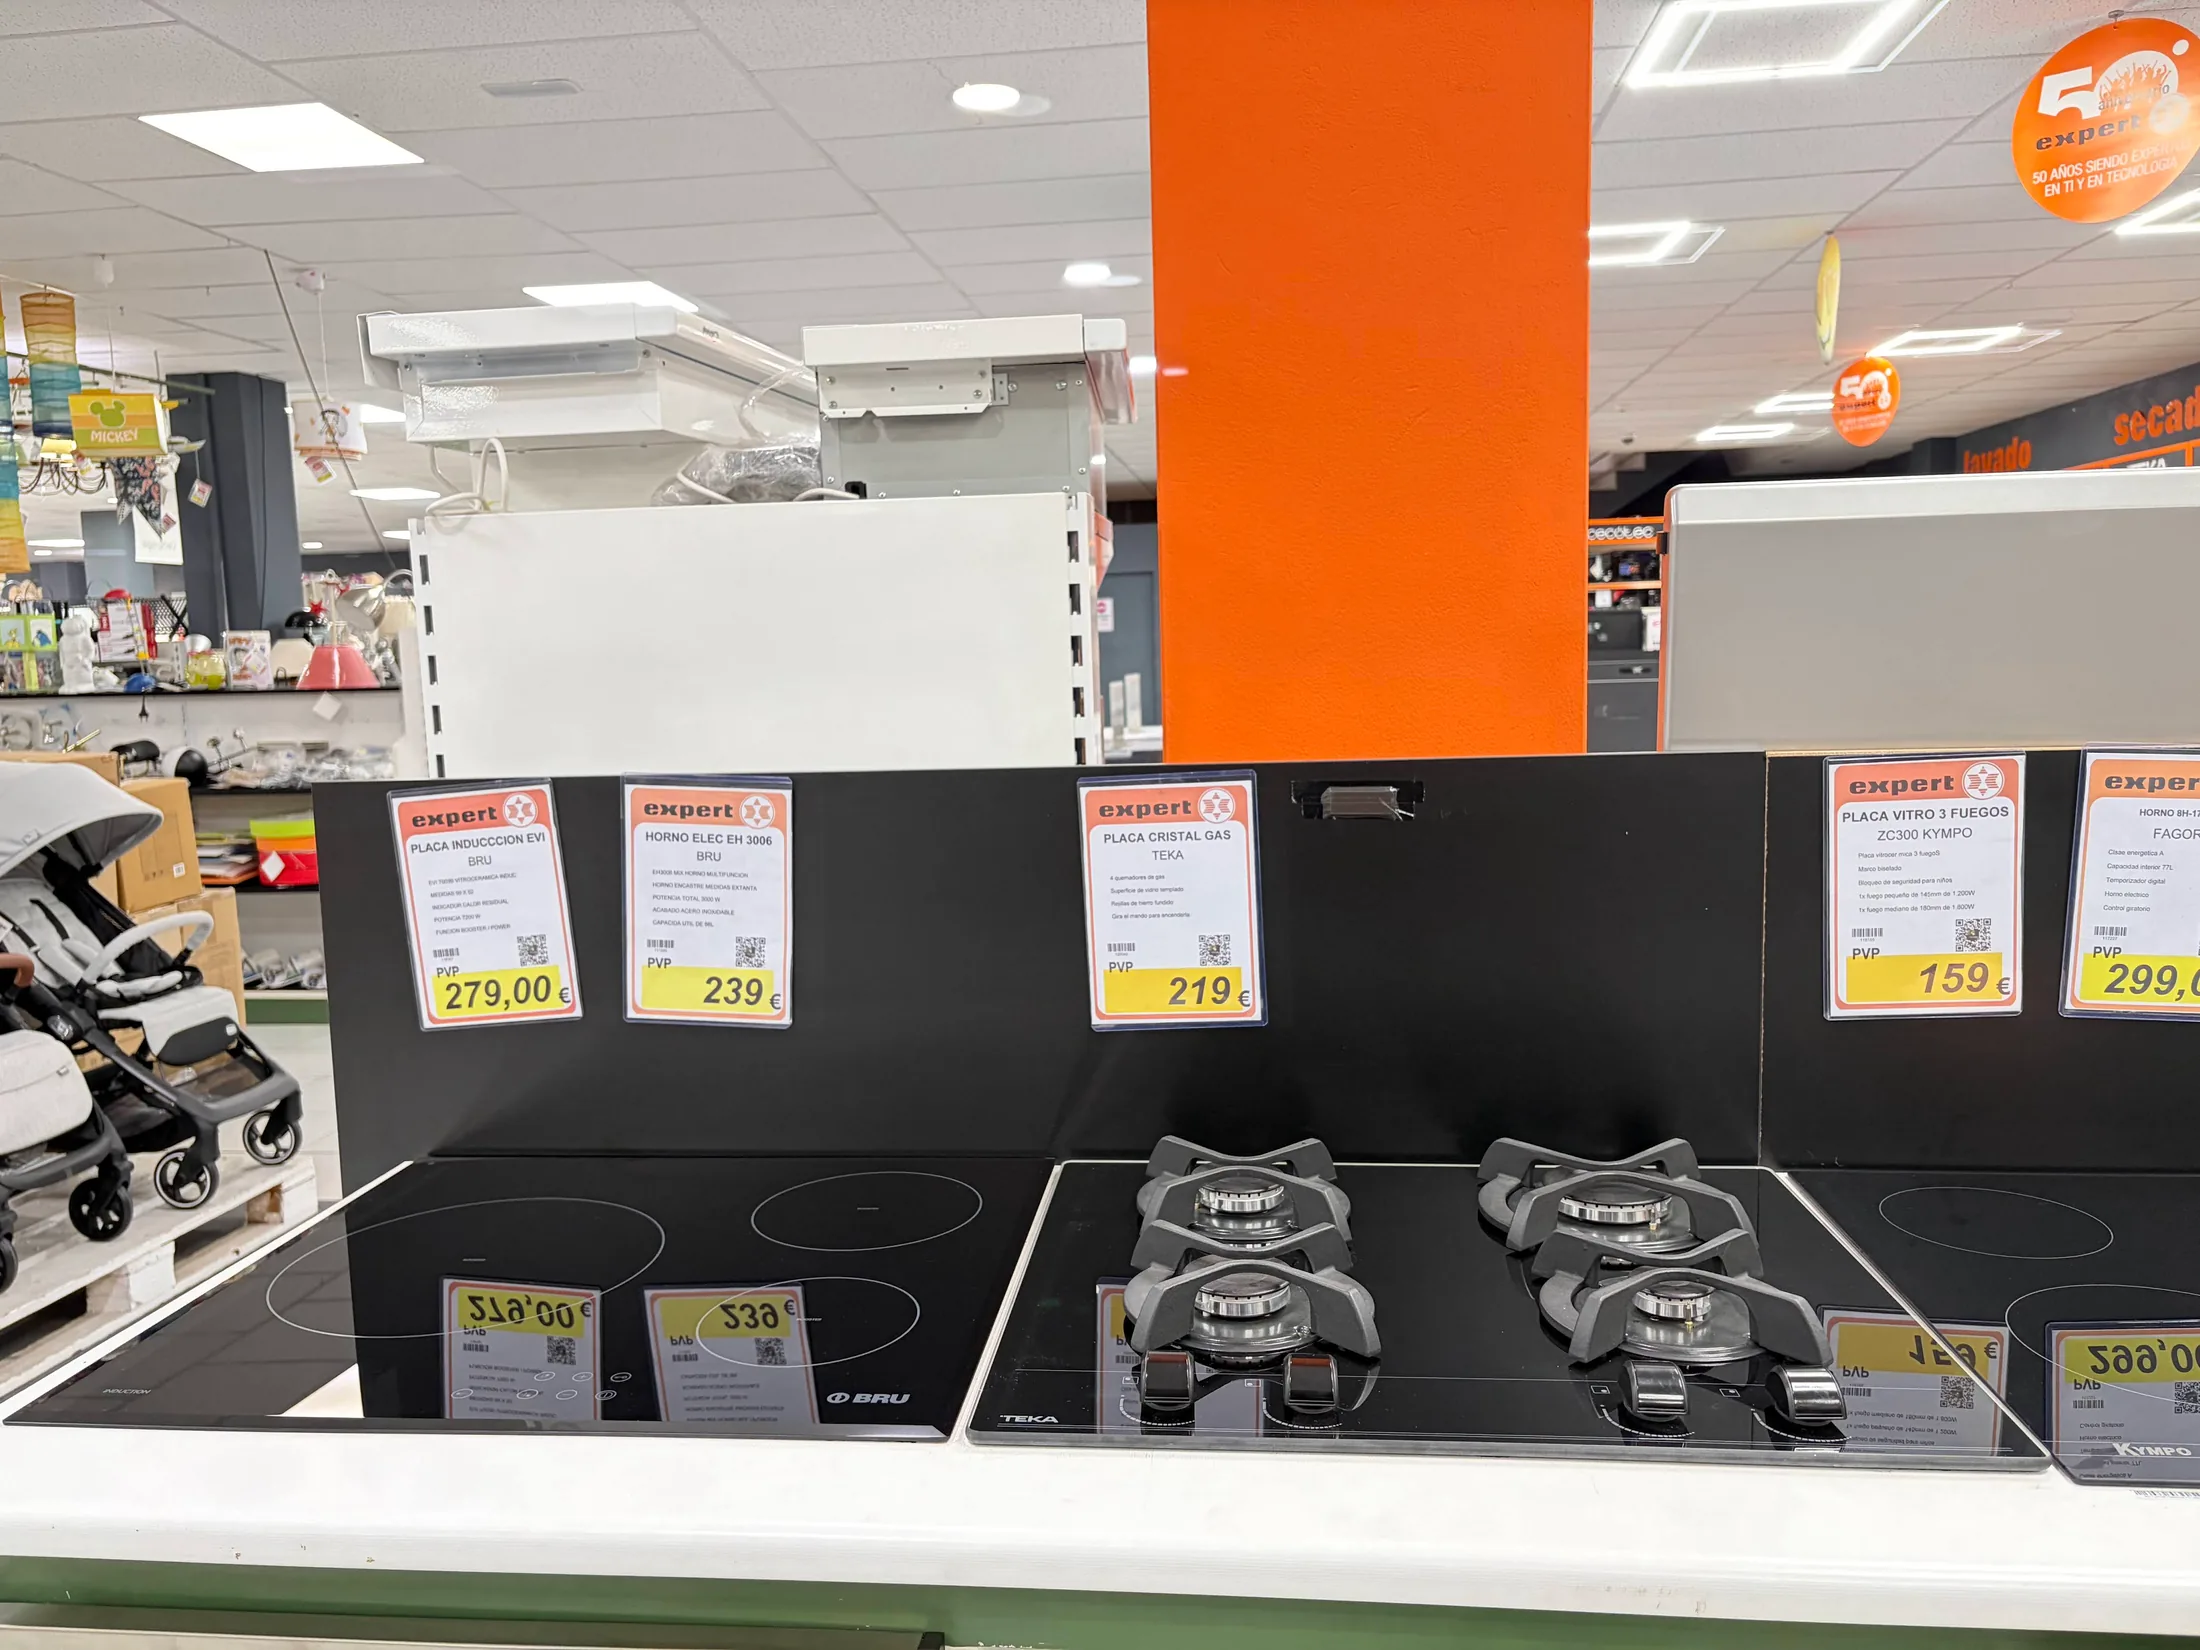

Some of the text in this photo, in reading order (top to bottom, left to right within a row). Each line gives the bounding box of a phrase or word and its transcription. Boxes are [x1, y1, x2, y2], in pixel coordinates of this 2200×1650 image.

[2036, 114, 2142, 150] expert
[2032, 153, 2129, 185] 50 AÑOS SIENDO
[2044, 182, 2060, 197] EN
[2063, 179, 2075, 193] TI
[2077, 176, 2084, 190] Y
[2087, 173, 2103, 189] EN
[91, 428, 139, 444] MICKEY
[1963, 436, 2033, 474] lavado
[1849, 775, 1954, 796] expert
[2105, 776, 2200, 793] exper
[412, 806, 498, 827] expert
[644, 803, 733, 819] expert
[1099, 800, 1192, 819] expert
[1842, 806, 2009, 823] PLACA VITRO 3 FUEGOS
[2139, 808, 2174, 817] HORNO
[645, 831, 772, 845] HORNO ELEC EH 3006
[1104, 829, 1231, 844] PLACA CRISTAL GAS
[1877, 826, 1973, 841] ZC300 KYMPO
[410, 841, 449, 854] PLACA
[526, 832, 546, 844] EVI
[468, 855, 492, 867] BRU
[697, 851, 722, 862] BRU
[1152, 850, 1184, 861] TEKA
[1858, 879, 1882, 887] Bloqueo
[1892, 878, 1921, 886] seguridad
[1866, 906, 1883, 914] fuego
[1852, 948, 1880, 960] PVP
[2093, 946, 2122, 958] PVP
[648, 957, 672, 969] PVP
[1109, 962, 1133, 973] PVP
[436, 965, 460, 978] PVP
[1919, 962, 2010, 995] 159 €
[445, 974, 571, 1011] 279,00 €
[703, 976, 782, 1010] 239 €
[1168, 976, 1251, 1007] 219 €
[853, 1393, 911, 1404] BRU
[1000, 1415, 1059, 1424] TEKA
[2112, 1442, 2192, 1456] KYMPO
